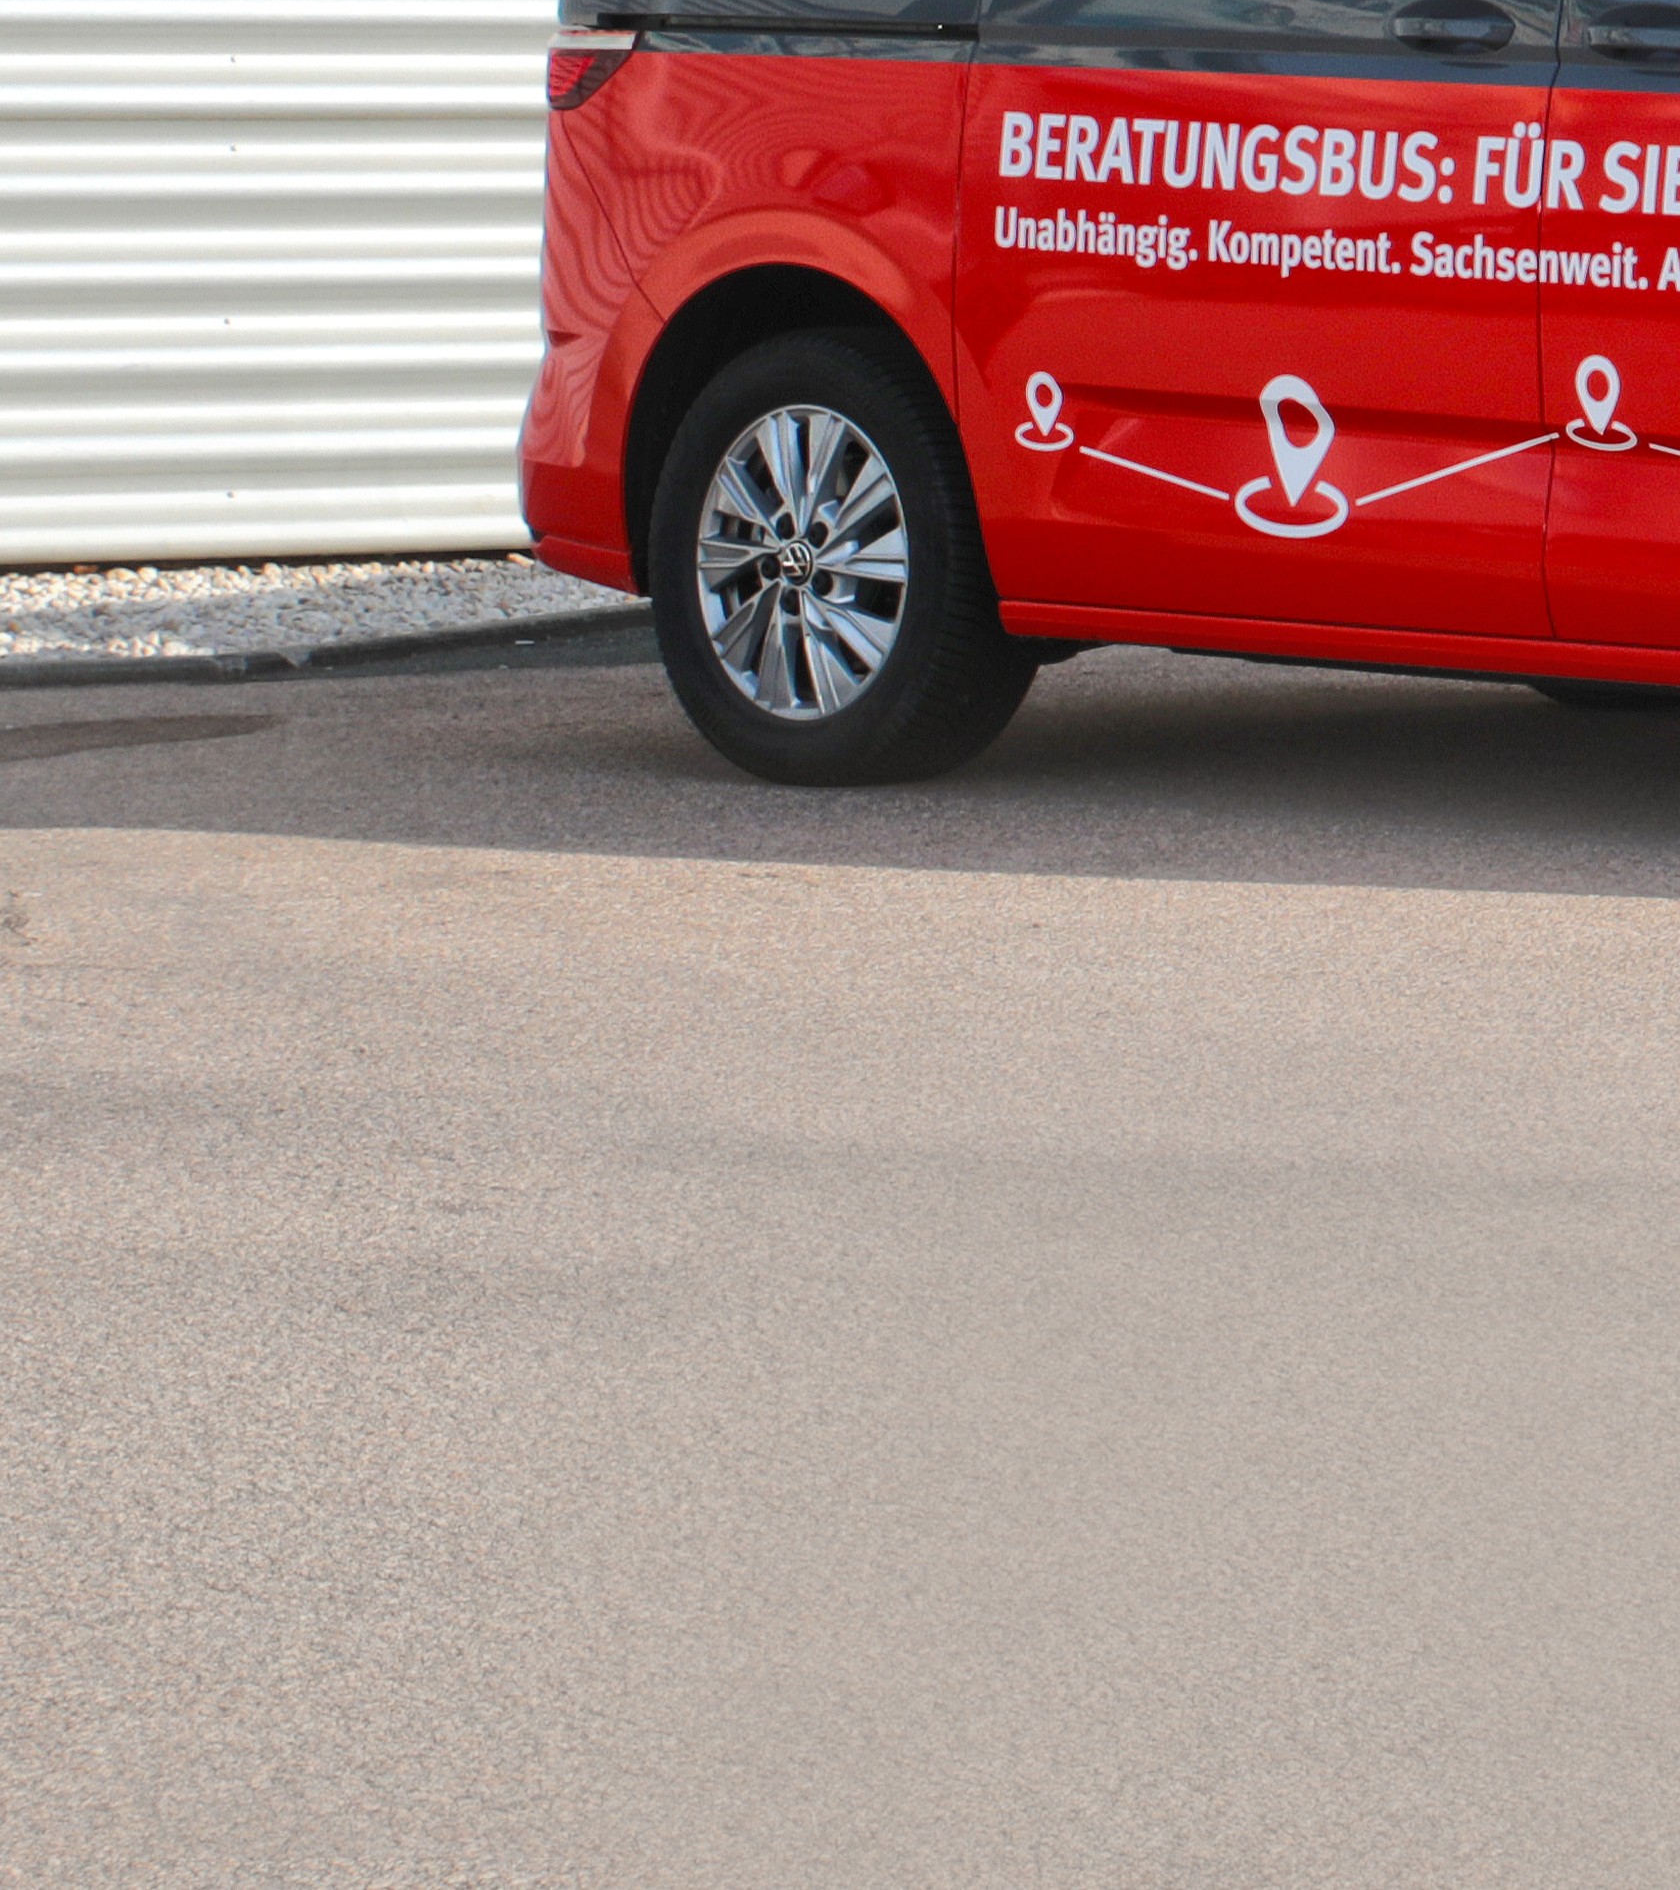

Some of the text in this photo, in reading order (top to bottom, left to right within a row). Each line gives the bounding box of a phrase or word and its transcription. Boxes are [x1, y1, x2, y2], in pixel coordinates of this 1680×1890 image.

[999, 111, 1455, 205] BERATUNGSBUS:
[1472, 121, 1585, 210] FÜR
[995, 206, 1198, 270] Unabhängig.
[1208, 219, 1401, 279] Kompetent.
[1409, 231, 1649, 290] Sachsenweit.
